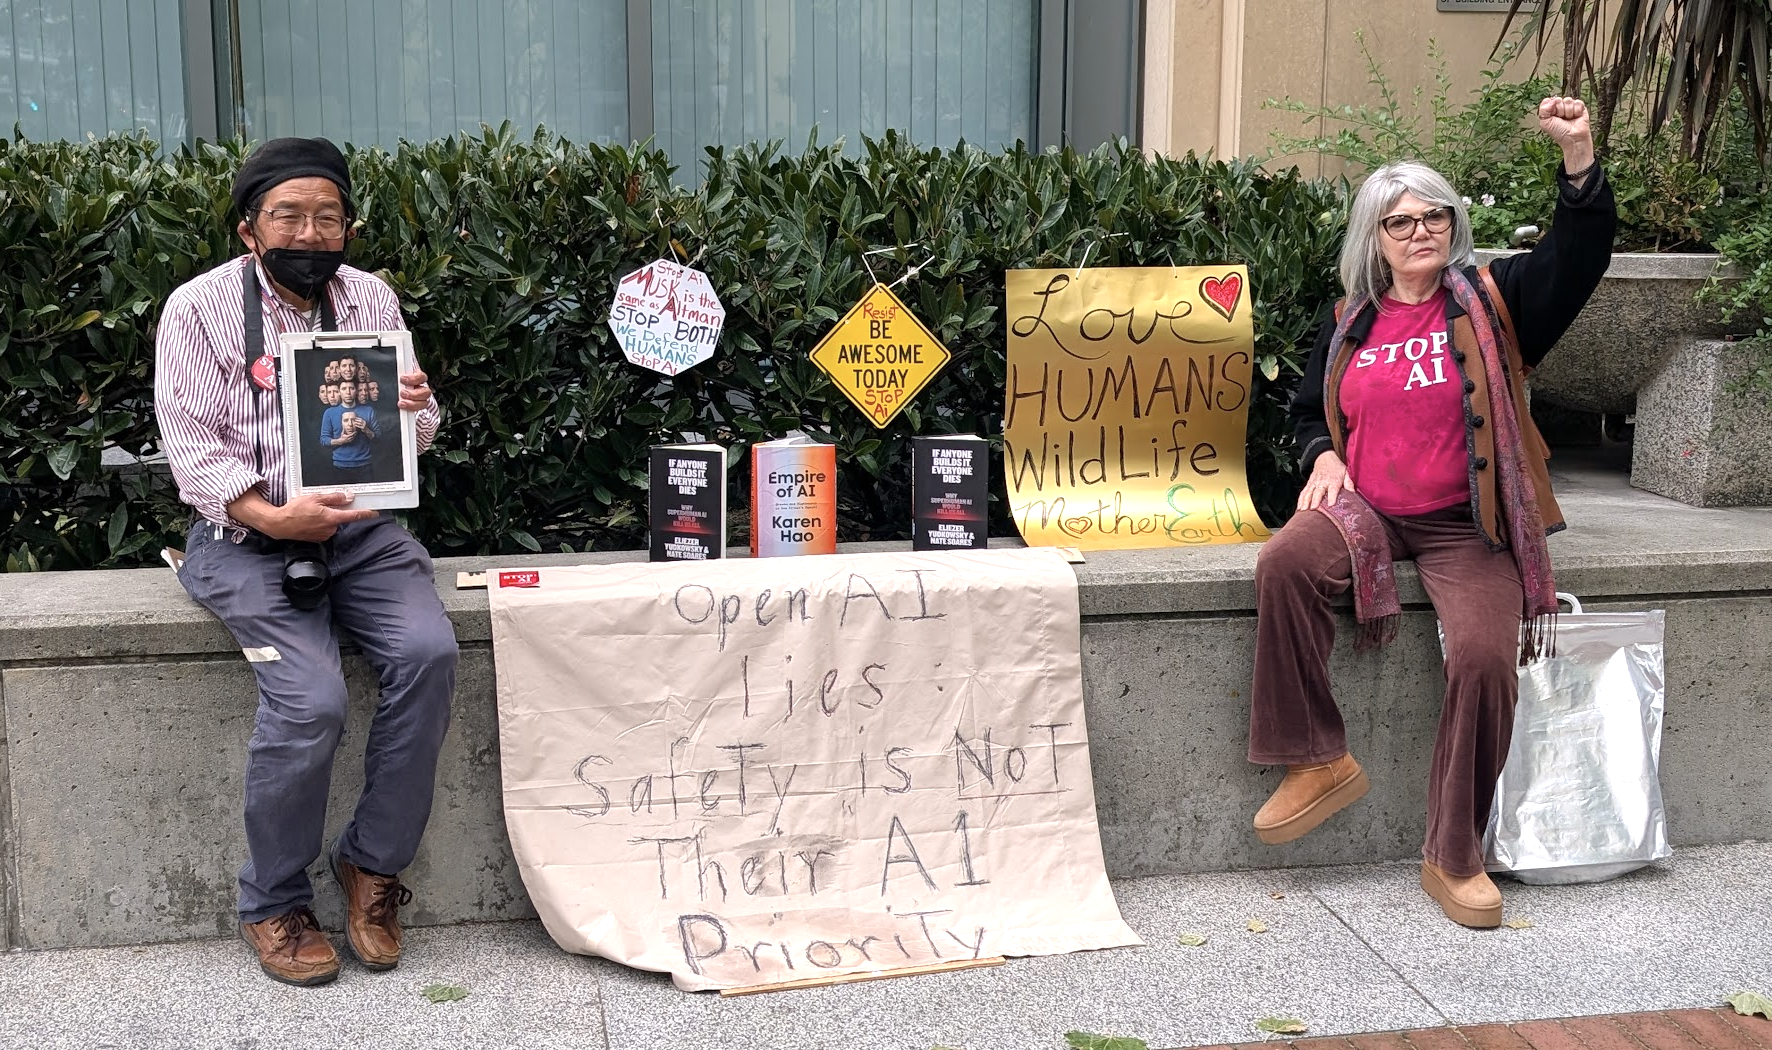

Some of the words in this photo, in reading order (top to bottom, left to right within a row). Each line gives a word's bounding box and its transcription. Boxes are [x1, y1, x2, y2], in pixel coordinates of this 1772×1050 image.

[621, 266, 680, 303] MUSK
[684, 290, 694, 302] is
[699, 292, 720, 310] the
[617, 292, 645, 307] same
[649, 302, 660, 310] as
[658, 296, 720, 327] Altman
[863, 302, 899, 320] Resist
[1012, 274, 1237, 361] Love
[613, 305, 659, 329] STOP
[674, 321, 719, 345] BOTH
[870, 320, 892, 339] BE
[616, 322, 636, 336] We
[643, 330, 698, 353] Defend
[625, 336, 697, 366] HUMANS
[838, 344, 924, 364] AWESOME
[1356, 331, 1448, 368] STOP
[853, 369, 909, 388] TODAY
[1404, 357, 1447, 391] AI
[1007, 352, 1249, 429] HUMANS
[932, 449, 940, 457] IF
[940, 450, 973, 458] ANYONE
[669, 459, 676, 467] IF
[676, 460, 708, 470] ANYONE
[934, 458, 962, 466] BUILDS
[670, 468, 697, 478] BUILDS
[932, 466, 973, 476] EVERYONE
[668, 476, 708, 487] EVERYONE
[768, 470, 826, 488] Empire
[943, 475, 961, 484] DIES
[679, 486, 697, 495] DIES
[776, 486, 795, 498] of
[797, 484, 816, 498] AI
[1166, 483, 1273, 544] Earth
[772, 515, 822, 529] Karen
[938, 524, 964, 532] ELIEZER
[675, 537, 700, 545] ELIEZER
[781, 530, 814, 543] Hao
[928, 530, 968, 539] YUDKOWSKY
[969, 532, 975, 540] &
[948, 538, 972, 546] SOARES
[664, 543, 703, 552] YUDKOWSKY
[704, 546, 709, 554] &
[666, 550, 682, 558] NATE
[682, 552, 706, 560] SOARES
[674, 584, 814, 652] Open
[840, 569, 948, 627] AI
